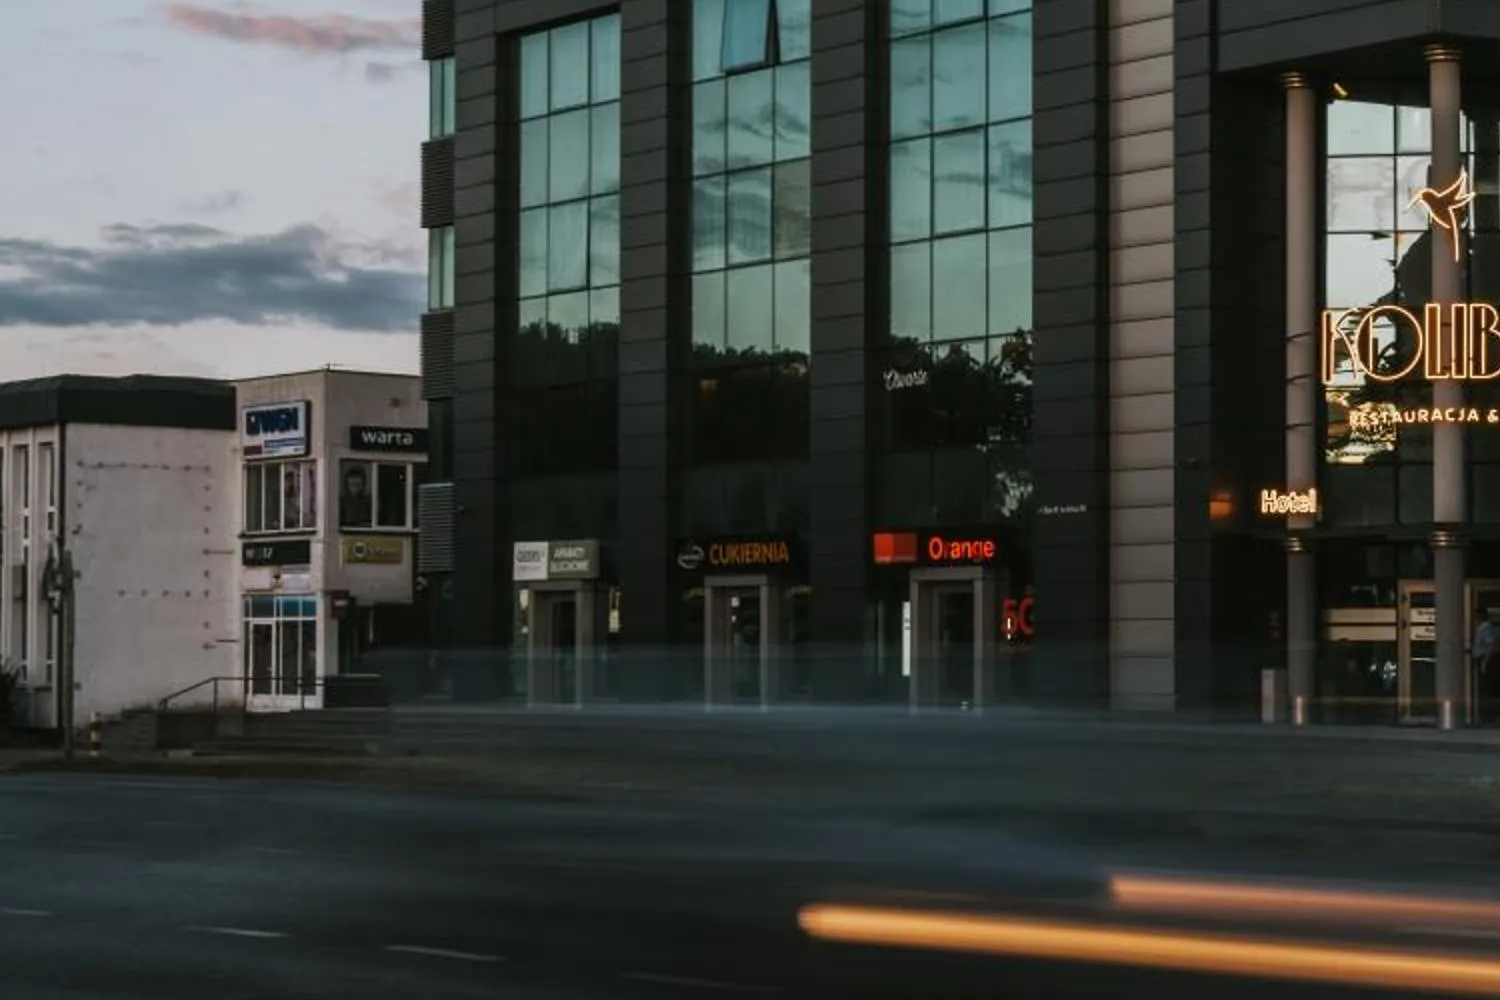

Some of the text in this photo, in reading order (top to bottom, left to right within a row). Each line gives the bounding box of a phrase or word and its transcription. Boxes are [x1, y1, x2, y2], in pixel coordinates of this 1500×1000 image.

[1349, 407, 1480, 428] RESTAURACJA
[1487, 409, 1499, 423] &
[361, 429, 415, 446] warta
[1261, 487, 1317, 513] Hotel
[708, 541, 790, 566] CUKIERNIA
[928, 535, 996, 562] Orange
